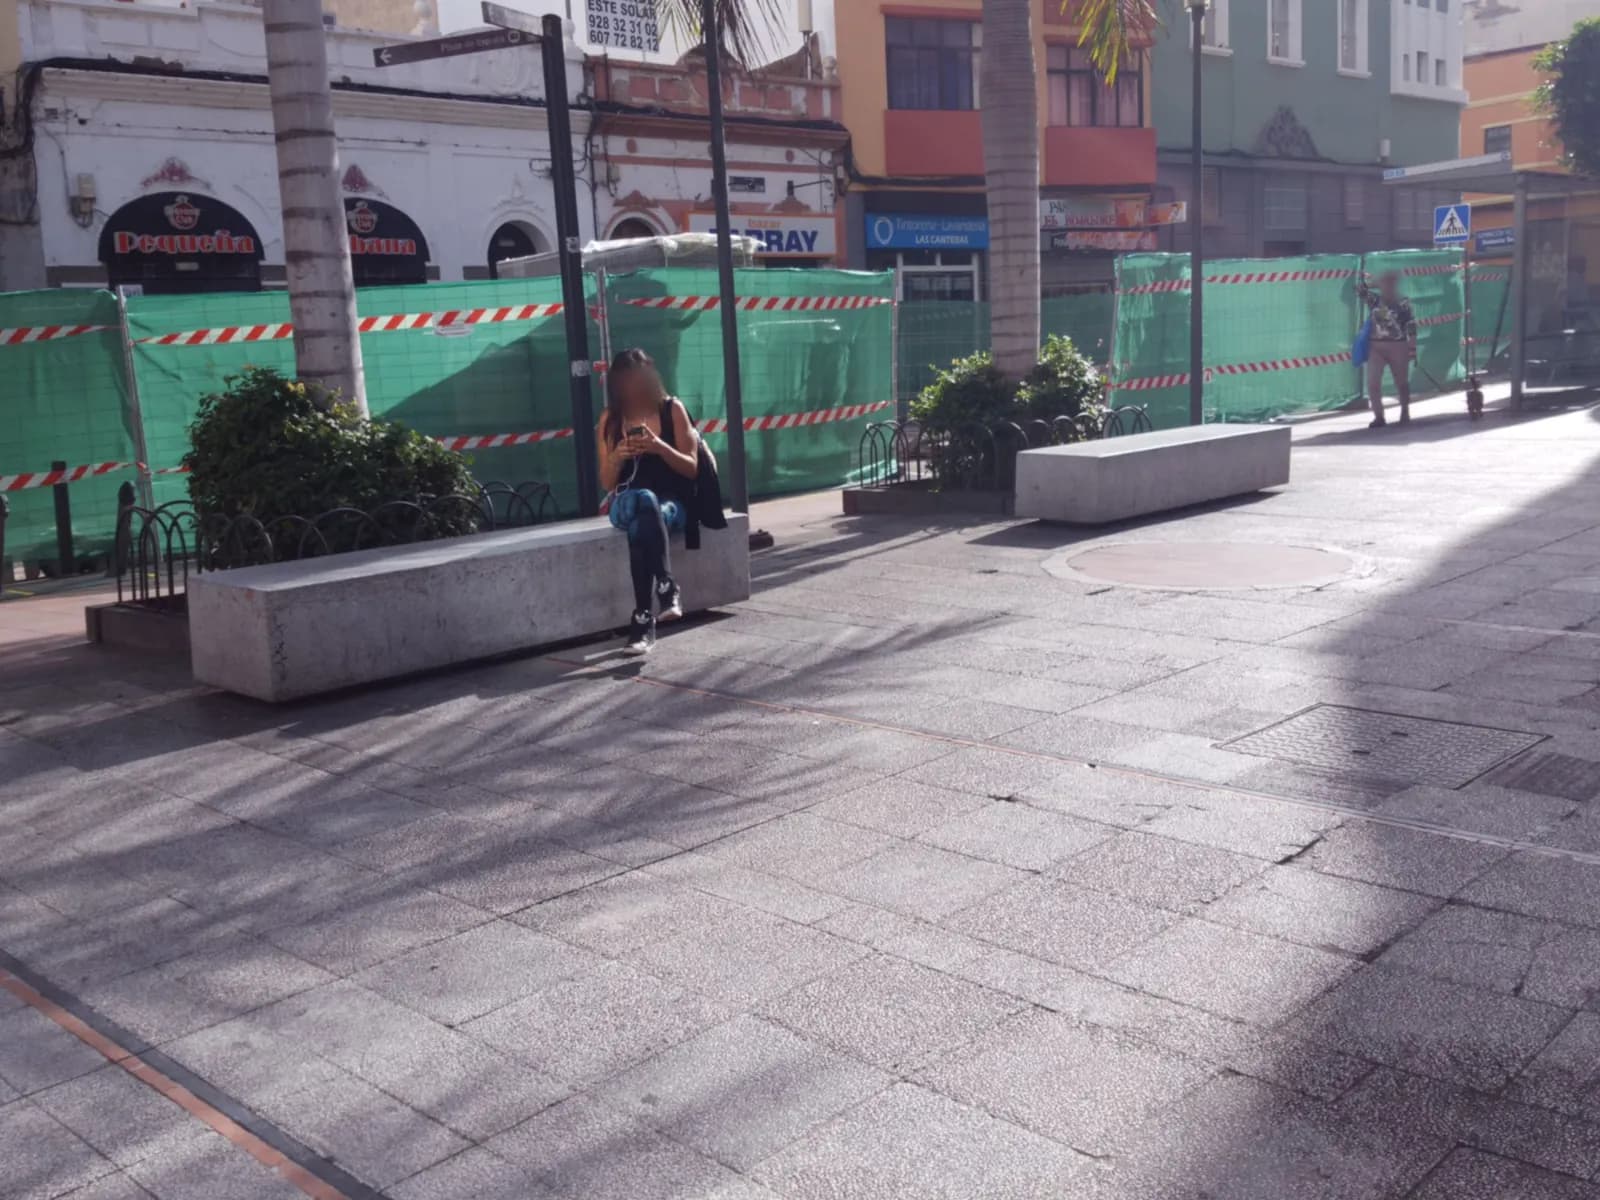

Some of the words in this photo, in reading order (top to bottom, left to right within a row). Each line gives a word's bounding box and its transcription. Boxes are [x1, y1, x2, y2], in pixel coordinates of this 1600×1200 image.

[588, 0, 617, 14] ESTE
[620, 3, 656, 20] SOLAR
[588, 14, 610, 30] 928
[613, 17, 626, 32] 32
[629, 20, 642, 34] 31
[644, 22, 658, 37] 02
[589, 30, 610, 45] 607
[613, 32, 627, 47] 72
[630, 35, 643, 49] 82
[646, 38, 659, 52] 12
[114, 229, 255, 254] Pequeña
